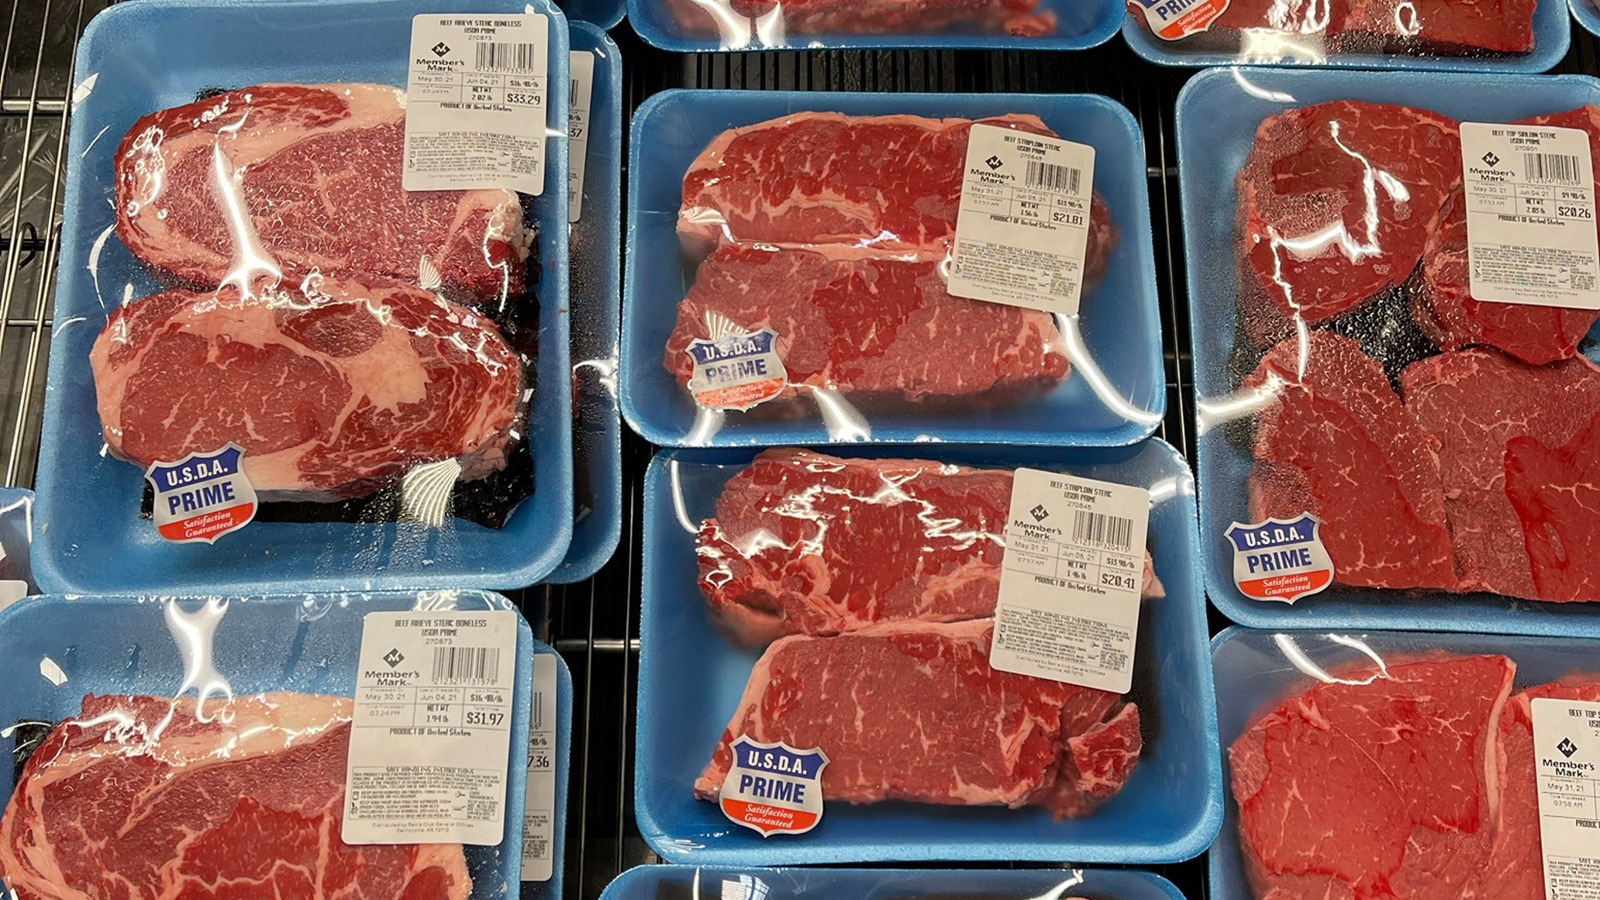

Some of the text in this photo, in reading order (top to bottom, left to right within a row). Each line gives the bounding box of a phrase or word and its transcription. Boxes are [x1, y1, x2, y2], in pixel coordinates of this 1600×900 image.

[1156, 0, 1196, 21] PRI
[1178, 4, 1212, 28] Satisfaction
[507, 93, 541, 105] $33.29
[971, 169, 1015, 180] Member's
[1469, 167, 1515, 176] Member's
[980, 176, 1004, 185] Mark
[1053, 212, 1083, 225] $21.81
[1558, 206, 1591, 218] $20.26
[703, 340, 761, 360] U.S.D.A.
[705, 358, 767, 384] PRIME
[166, 459, 228, 487] U.S.D.A.
[168, 481, 235, 516] PRIME
[184, 512, 231, 529] Satisfaction
[185, 518, 233, 538] Guaranteed
[1014, 520, 1062, 535] Member's
[1025, 530, 1050, 540] Mark
[1245, 527, 1305, 547] U.S.D.A.
[1247, 548, 1312, 574] PRIME
[1102, 573, 1135, 589] $20.41
[1263, 576, 1308, 588] Satisfaction
[1264, 582, 1311, 596] Guaranteed
[466, 712, 504, 725] $31.97
[449, 728, 471, 736] States
[748, 750, 807, 775] U.S.D.A.
[1542, 759, 1594, 771] Member's
[1556, 768, 1583, 777] Mark
[739, 774, 806, 804] PRIME
[746, 804, 794, 819] Satisfaction
[744, 813, 794, 828] Guaranteed
